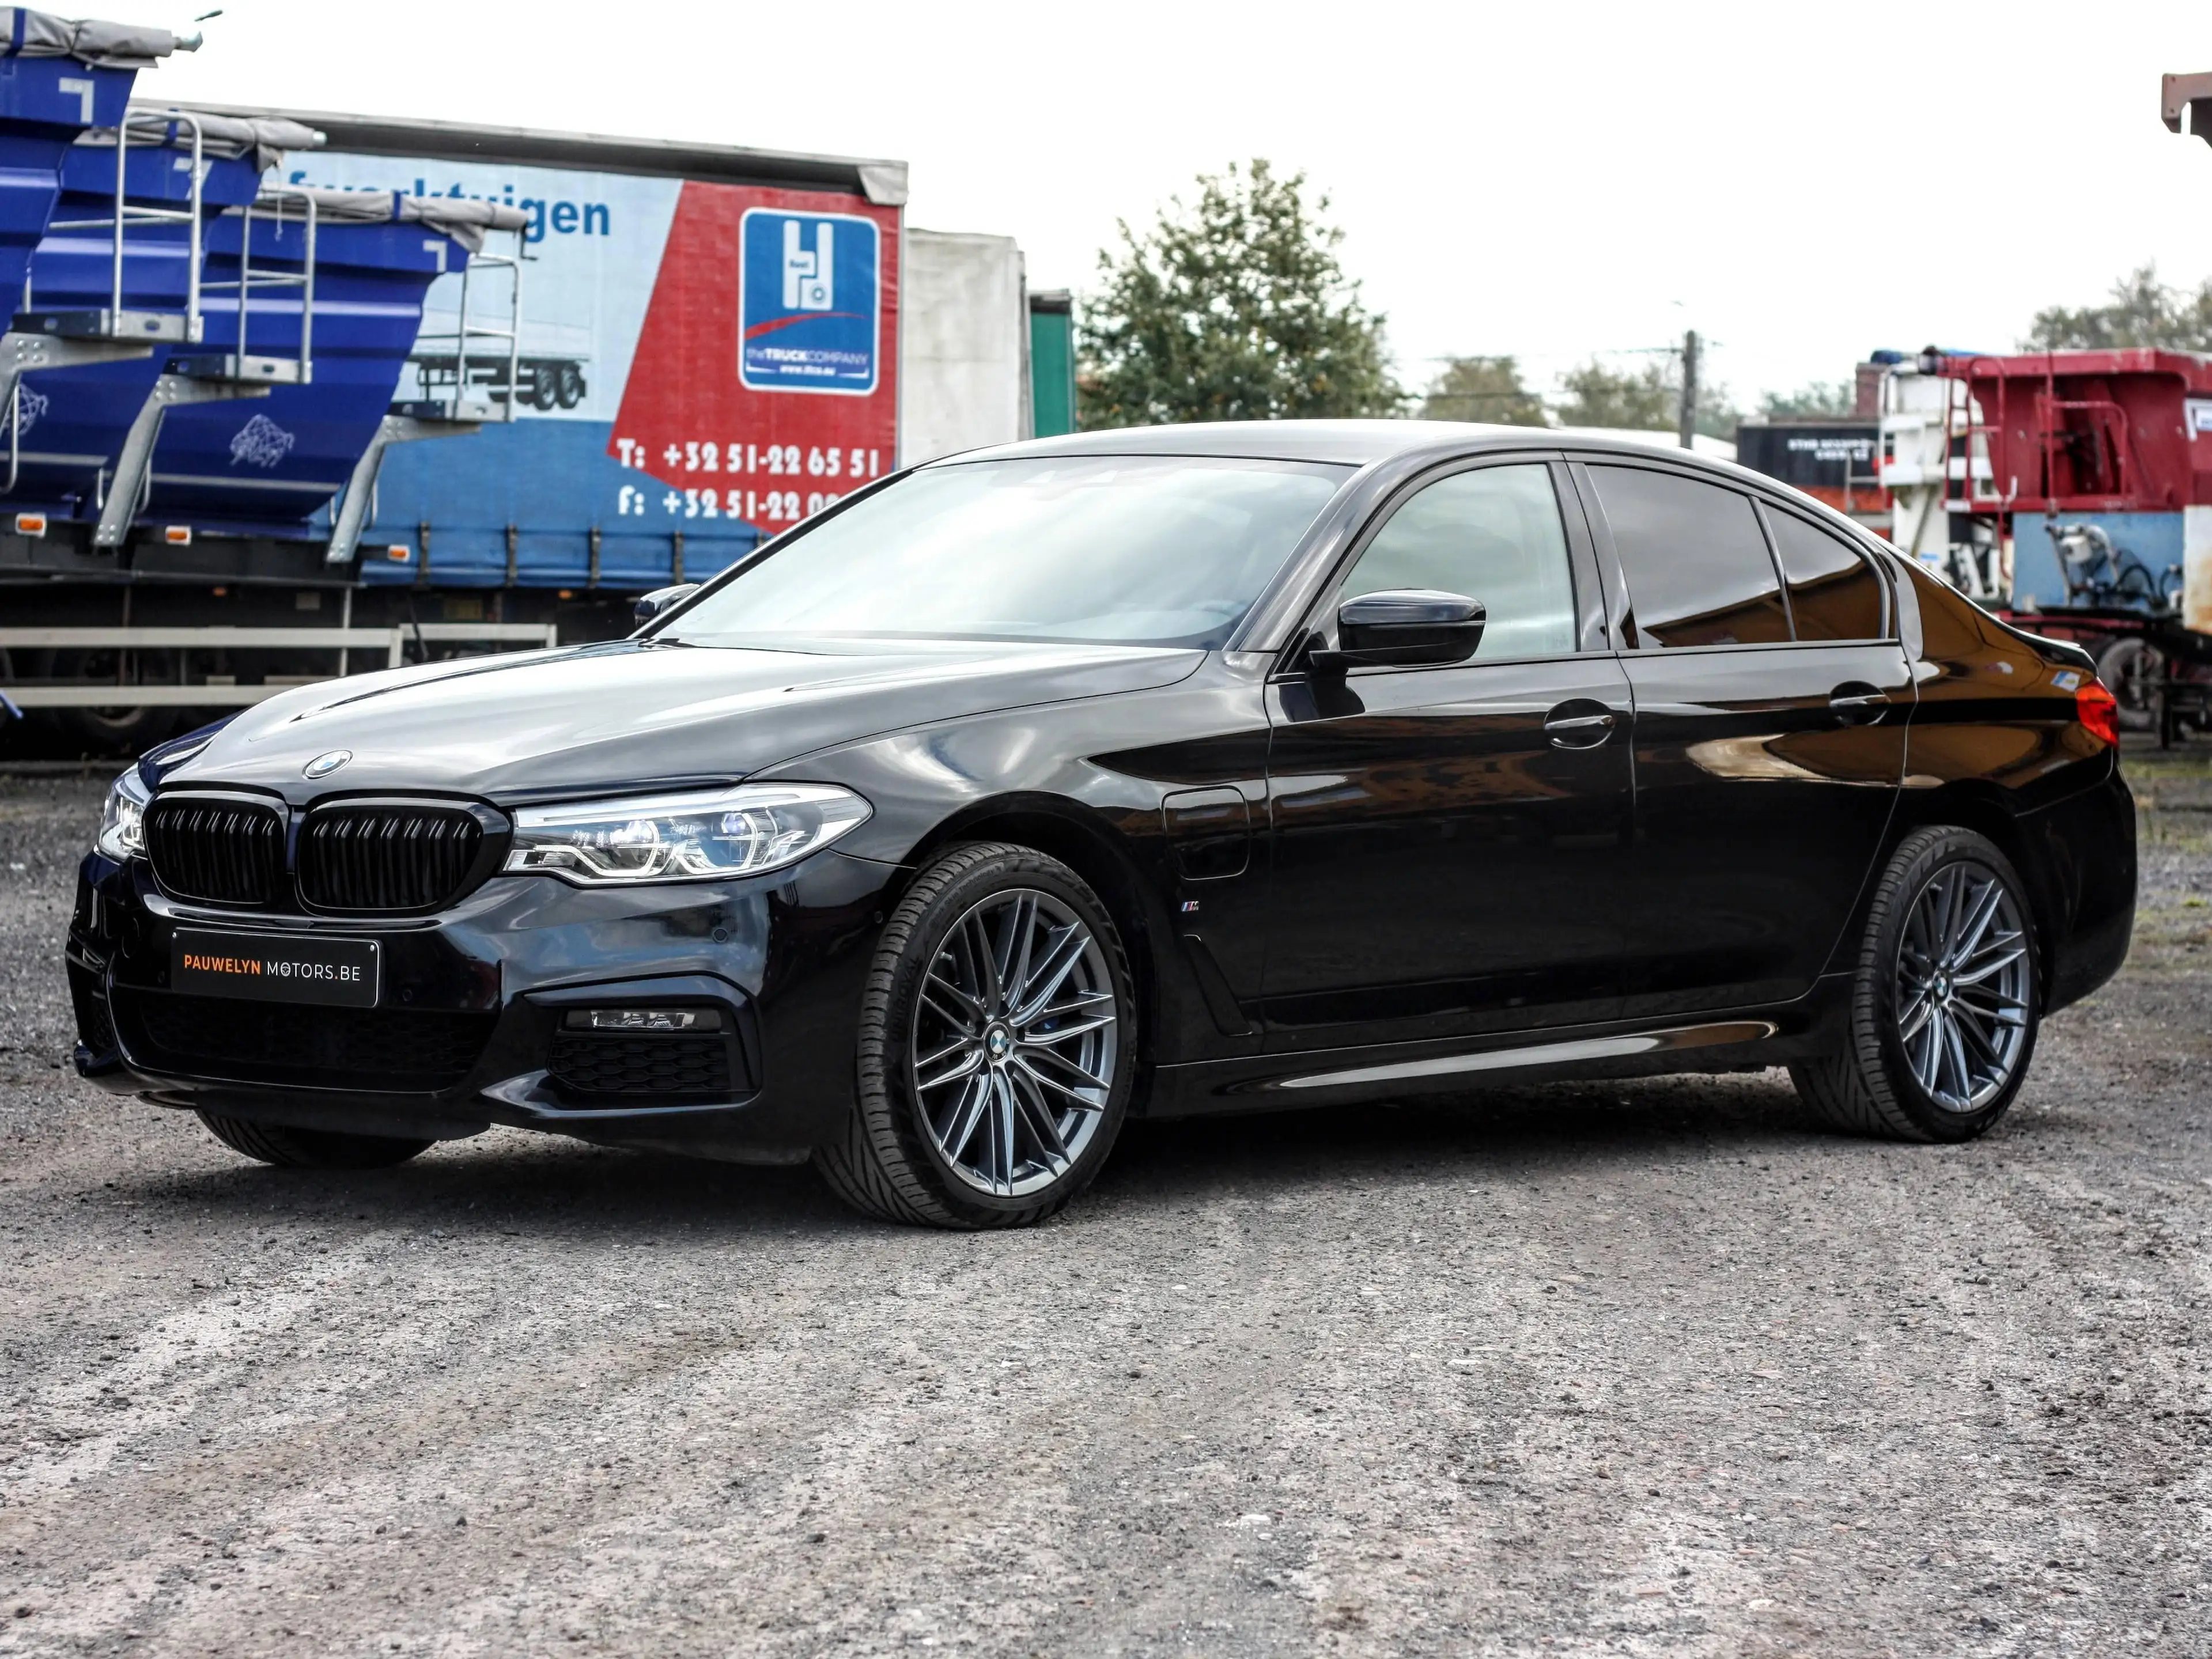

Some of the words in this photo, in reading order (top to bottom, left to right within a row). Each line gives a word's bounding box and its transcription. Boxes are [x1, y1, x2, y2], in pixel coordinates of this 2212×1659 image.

[617, 438, 645, 469] T:
[663, 441, 719, 472] +32
[727, 443, 801, 475] 51-22
[808, 446, 841, 476] 65
[849, 448, 879, 478] 51
[663, 488, 718, 518] +32
[726, 488, 800, 520] 51-22
[184, 954, 261, 975] PAUWELYN
[267, 961, 361, 981] MOTORS.BE
